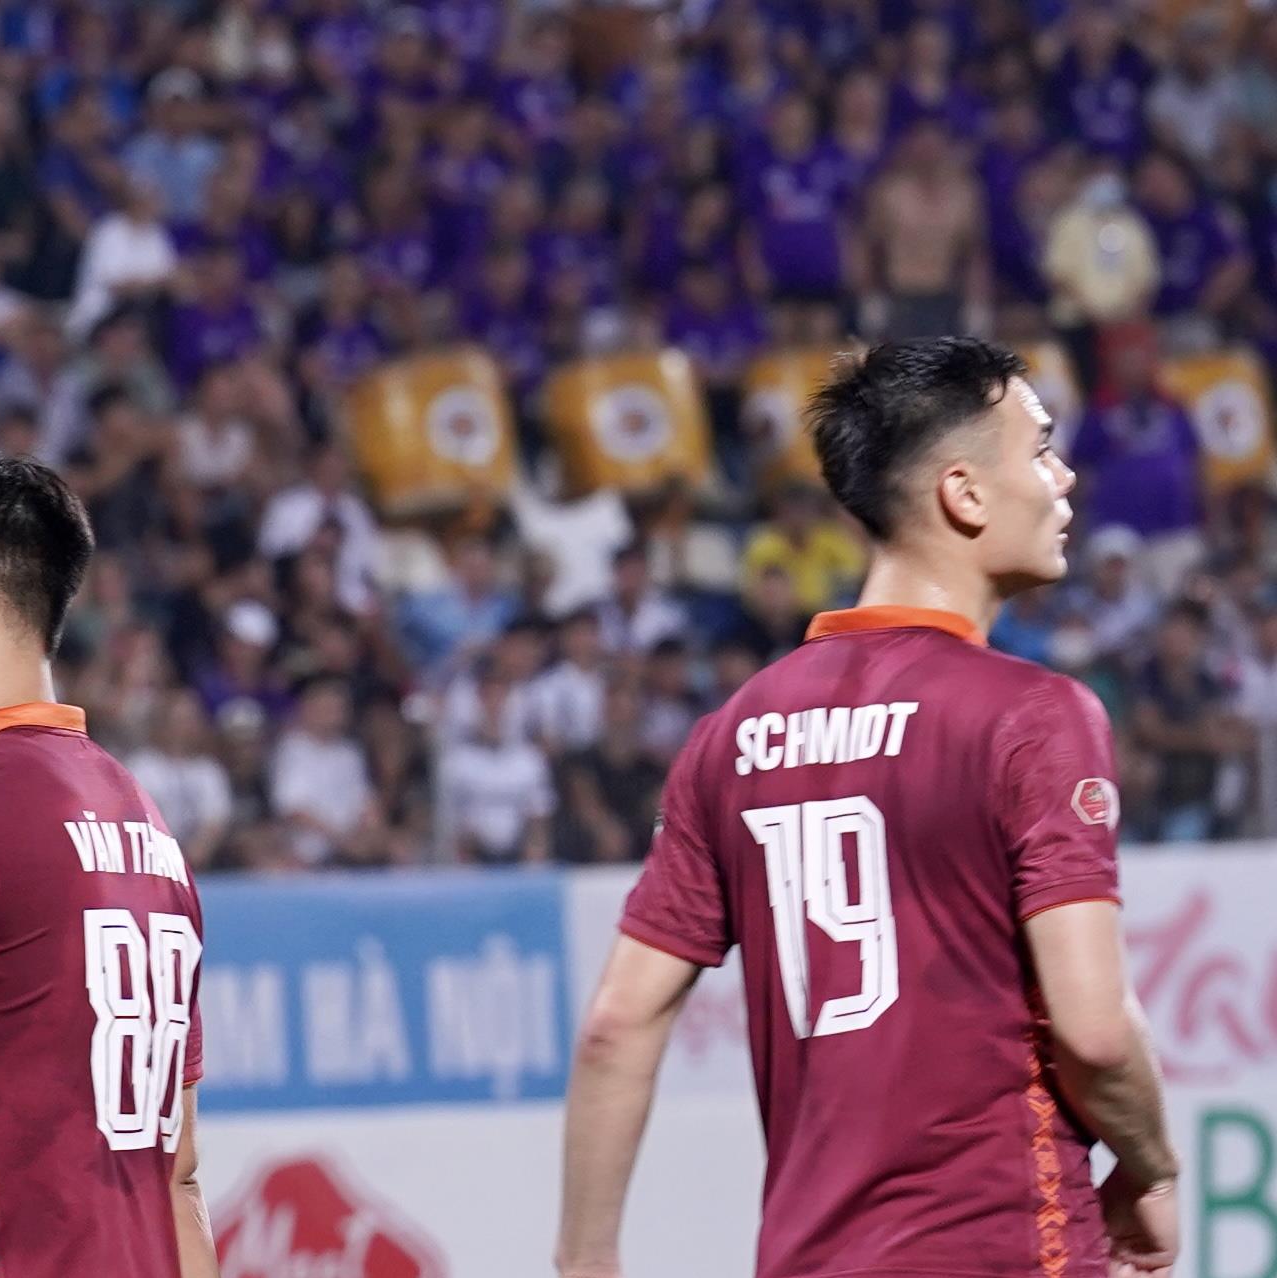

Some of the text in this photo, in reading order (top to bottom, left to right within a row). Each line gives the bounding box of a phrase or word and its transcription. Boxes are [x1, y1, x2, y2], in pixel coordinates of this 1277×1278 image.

[735, 701, 919, 776] SCHMIDT
[302, 934, 412, 1084] HÀ
[427, 932, 558, 1102] NỘI
[740, 795, 899, 1040] 19
[83, 908, 203, 1154] 88
